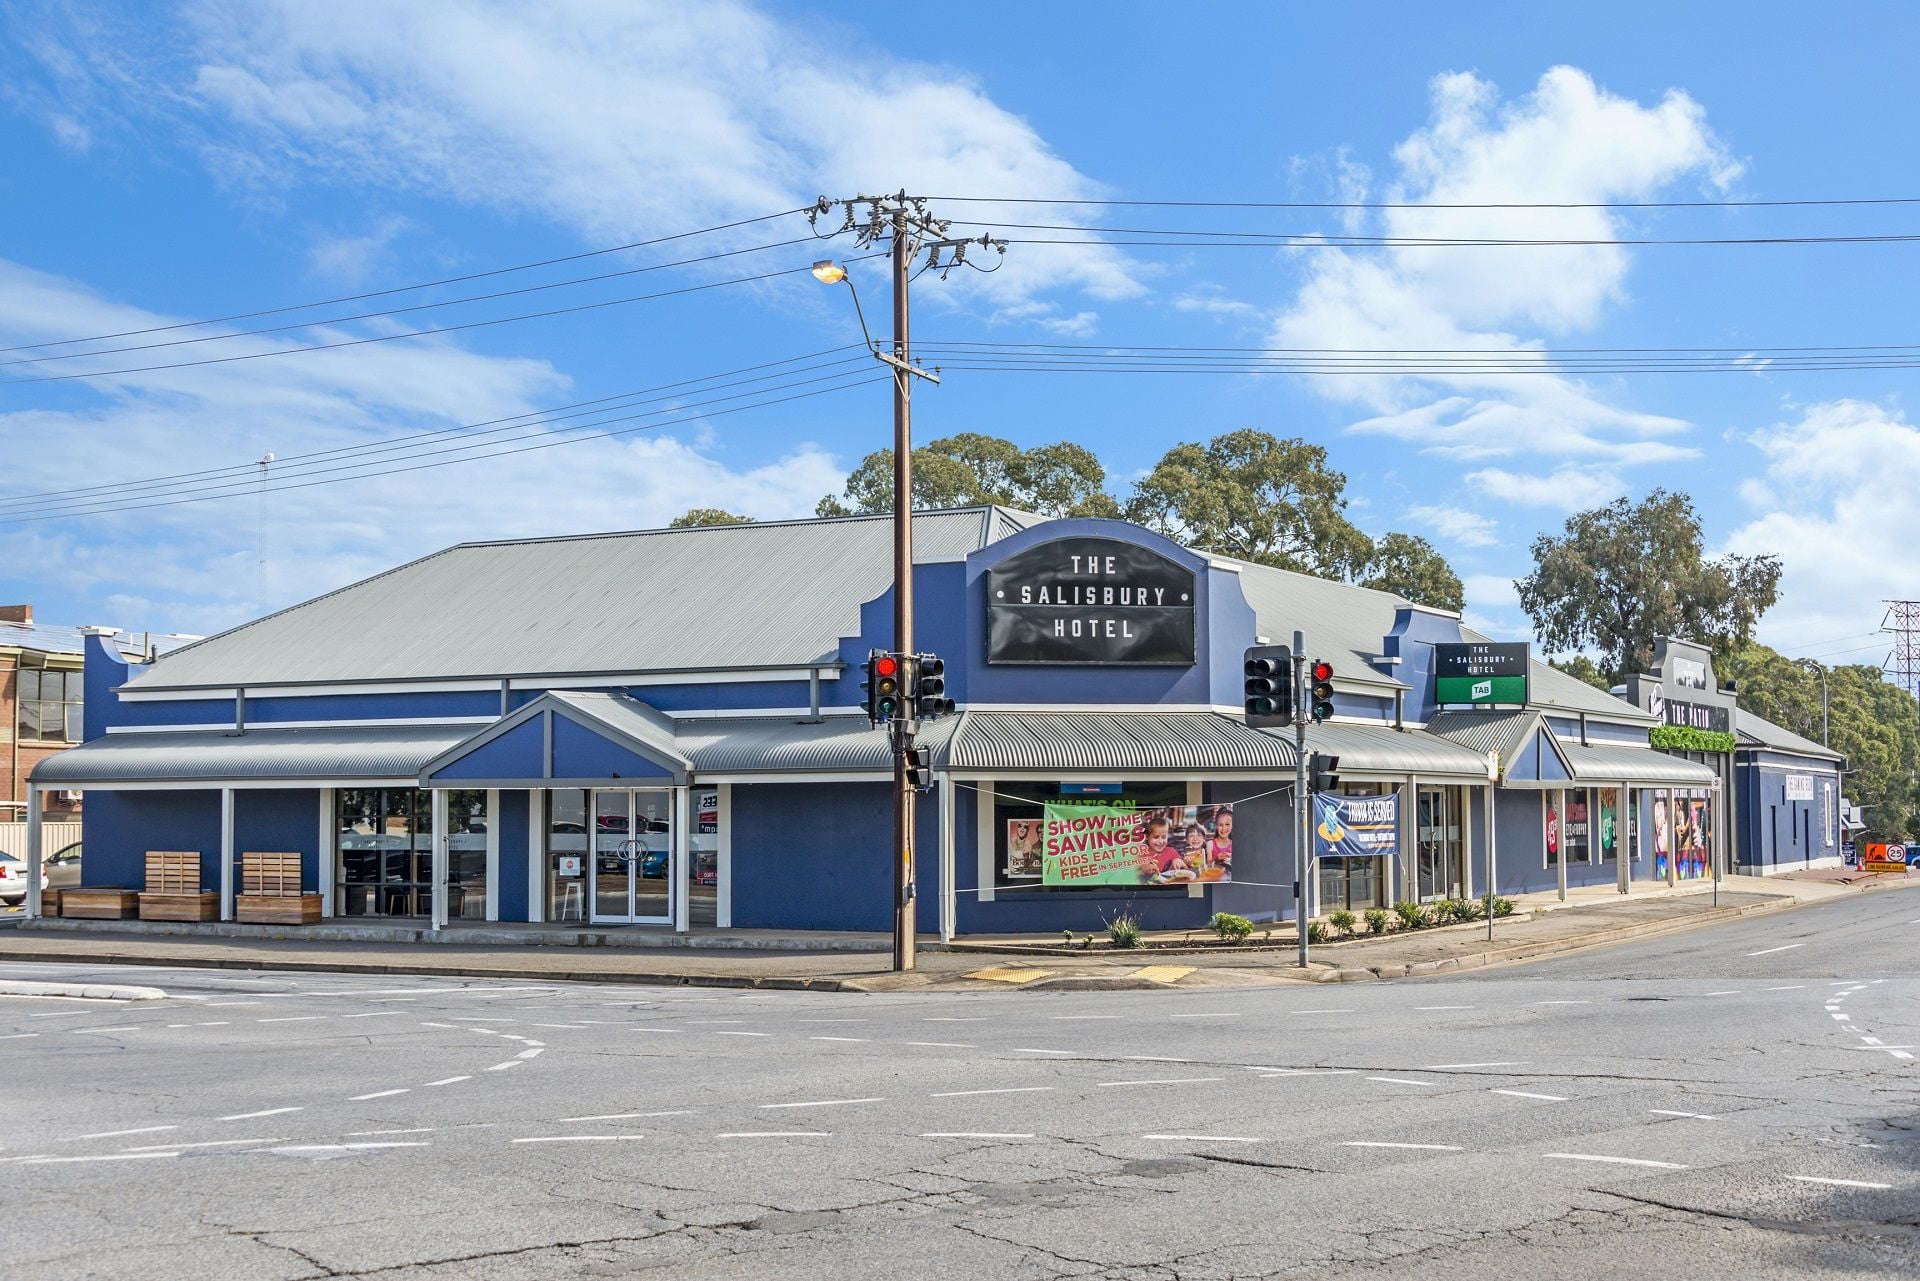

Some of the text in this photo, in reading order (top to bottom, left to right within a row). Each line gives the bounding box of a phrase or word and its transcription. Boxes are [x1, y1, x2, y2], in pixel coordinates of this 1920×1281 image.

[1071, 555, 1116, 574] THE
[1021, 585, 1165, 606] SALISBURY
[1054, 618, 1133, 638] HOTEL
[1456, 656, 1506, 664] SALISBURY
[1472, 646, 1489, 654] THE
[1473, 686, 1490, 694] TAB
[1671, 704, 1686, 726] THE
[1688, 706, 1709, 729] PATIO
[1047, 815, 1107, 837] SHOW
[1046, 826, 1147, 857] SAVINGS
[1059, 853, 1089, 868] KIDS
[1093, 849, 1117, 862] EAT
[1121, 844, 1150, 858] FOR
[1890, 849, 1902, 858] 25
[1060, 863, 1099, 880] FREE
[1108, 856, 1154, 870] SEPTEMBER
